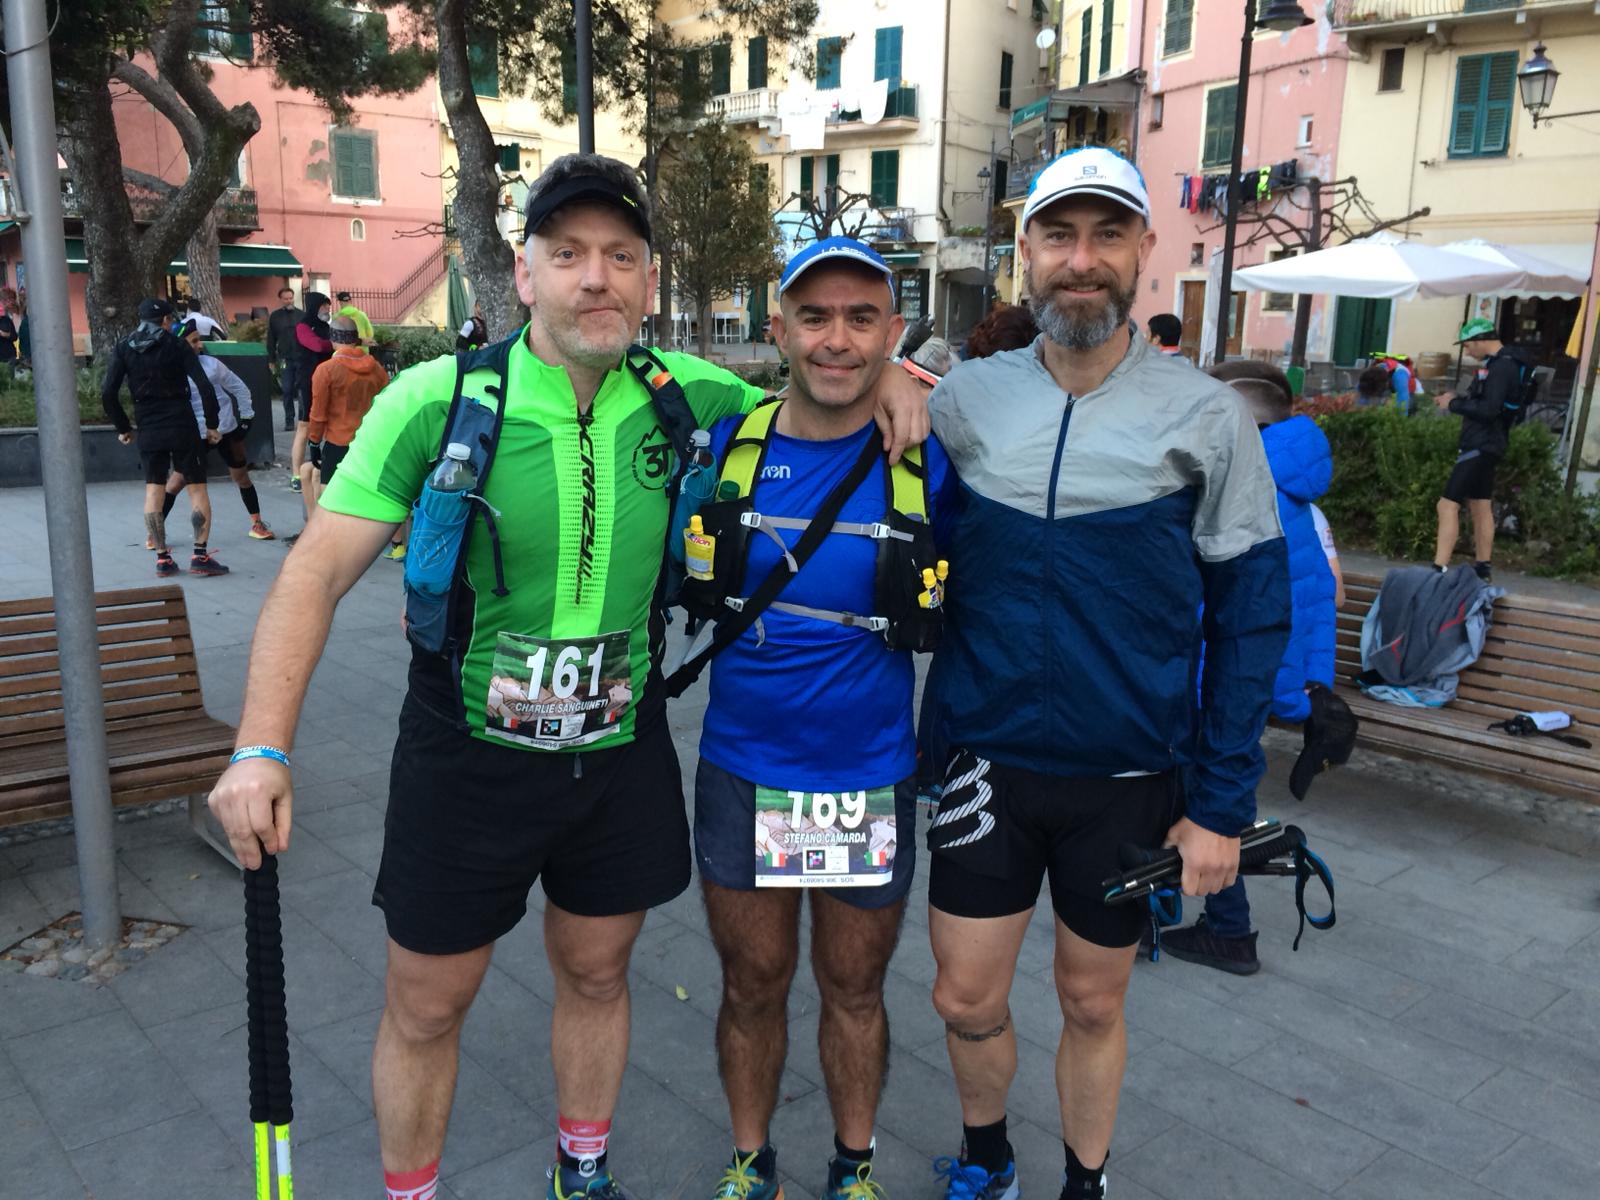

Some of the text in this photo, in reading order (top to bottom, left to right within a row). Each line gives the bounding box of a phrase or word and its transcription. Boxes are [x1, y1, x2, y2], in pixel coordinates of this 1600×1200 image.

[526, 642, 605, 701] 161
[515, 698, 609, 714] CHARLIE SANGUINETI
[787, 791, 867, 829] 169
[784, 832, 867, 844] STEFANO CAMARDA
